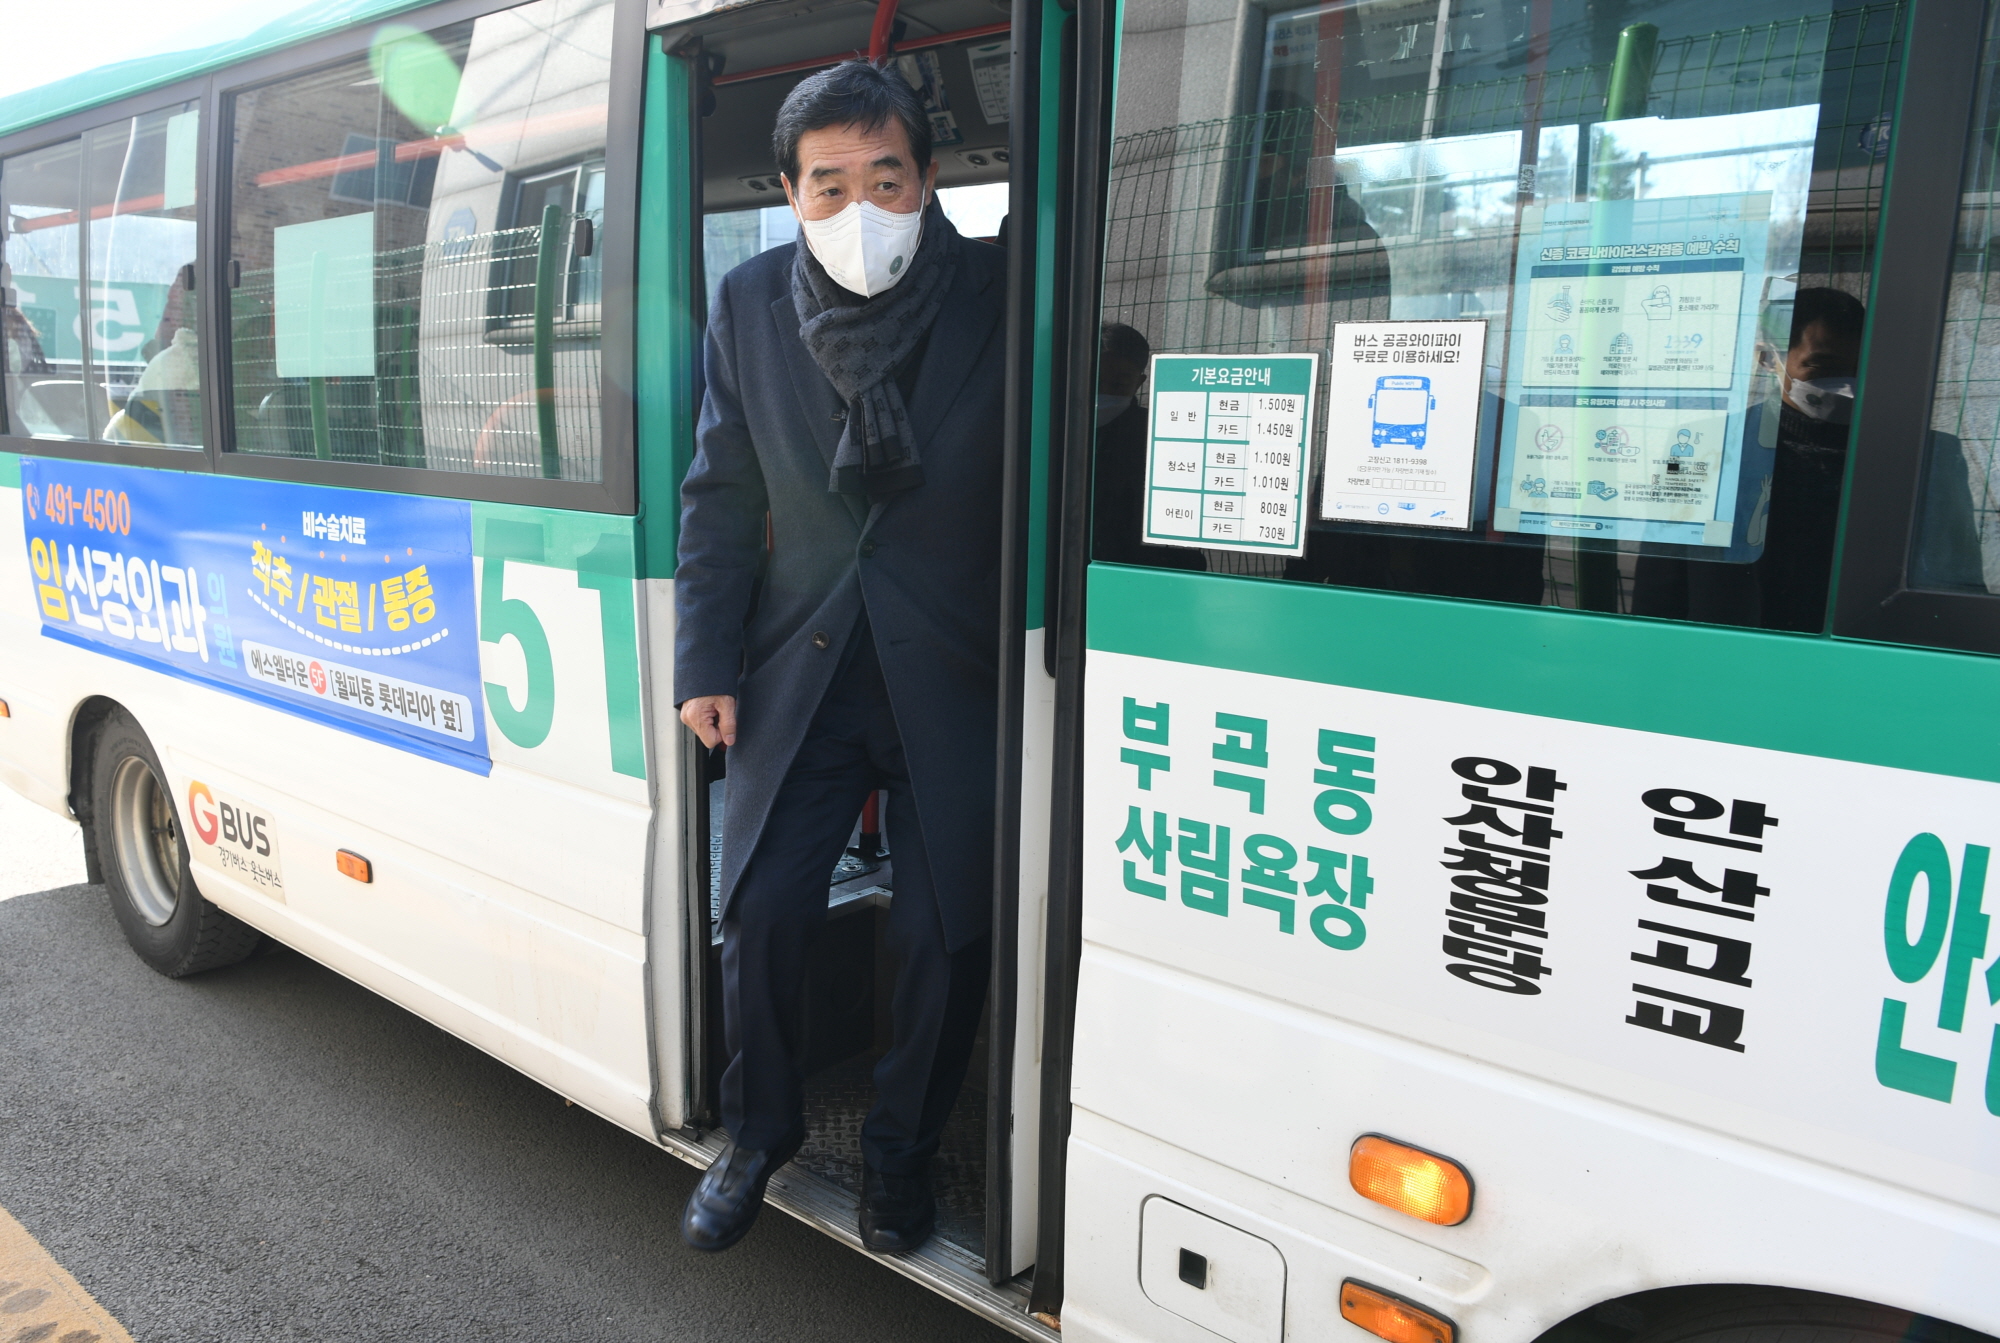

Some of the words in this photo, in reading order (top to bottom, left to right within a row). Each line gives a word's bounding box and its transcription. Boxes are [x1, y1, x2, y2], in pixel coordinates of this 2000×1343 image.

[1541, 247, 1564, 261] 신종
[1565, 242, 1684, 260] 코로나바이러스감염증
[1686, 240, 1712, 255] 예방
[1713, 238, 1740, 254] 수칙
[1354, 334, 1378, 347] 버스
[1383, 333, 1461, 347] 공공와이파이
[1664, 333, 1703, 349] 1339
[1353, 350, 1388, 363] 무료로
[1393, 350, 1460, 363] 이용하세요!
[1192, 368, 1271, 386] 기본요금안내
[1219, 399, 1240, 412] 현금
[1259, 398, 1295, 412] 1.500원
[1218, 424, 1239, 435] 카드
[1257, 423, 1293, 437] 1.450원
[1167, 460, 1196, 473] 청소년
[1215, 452, 1237, 464] 현금
[1254, 451, 1291, 466] 1.100원
[1367, 456, 1391, 464] 고장신고
[1393, 457, 1428, 465] 1811-9398
[1214, 475, 1235, 488] 카드
[1252, 475, 1290, 491] 1.010원
[1348, 477, 1371, 486] 차량번호
[44, 483, 131, 536] 491-4500
[1165, 508, 1193, 520] 어린이
[1213, 499, 1235, 513] 현금
[1260, 502, 1287, 516] 800원
[302, 511, 367, 545] 비수술치료
[1212, 522, 1233, 535] 카드
[1259, 526, 1286, 540] 730원
[480, 518, 647, 780] 51
[250, 648, 309, 689] 에스엘타운
[378, 687, 436, 726] 롯데리아
[218, 846, 248, 871] 경기버스
[1114, 805, 1375, 951] 산림욕장
[1439, 756, 1567, 995] 안산청문당
[1625, 788, 1779, 1053] 안산고교
[1875, 832, 2000, 1118] 안
